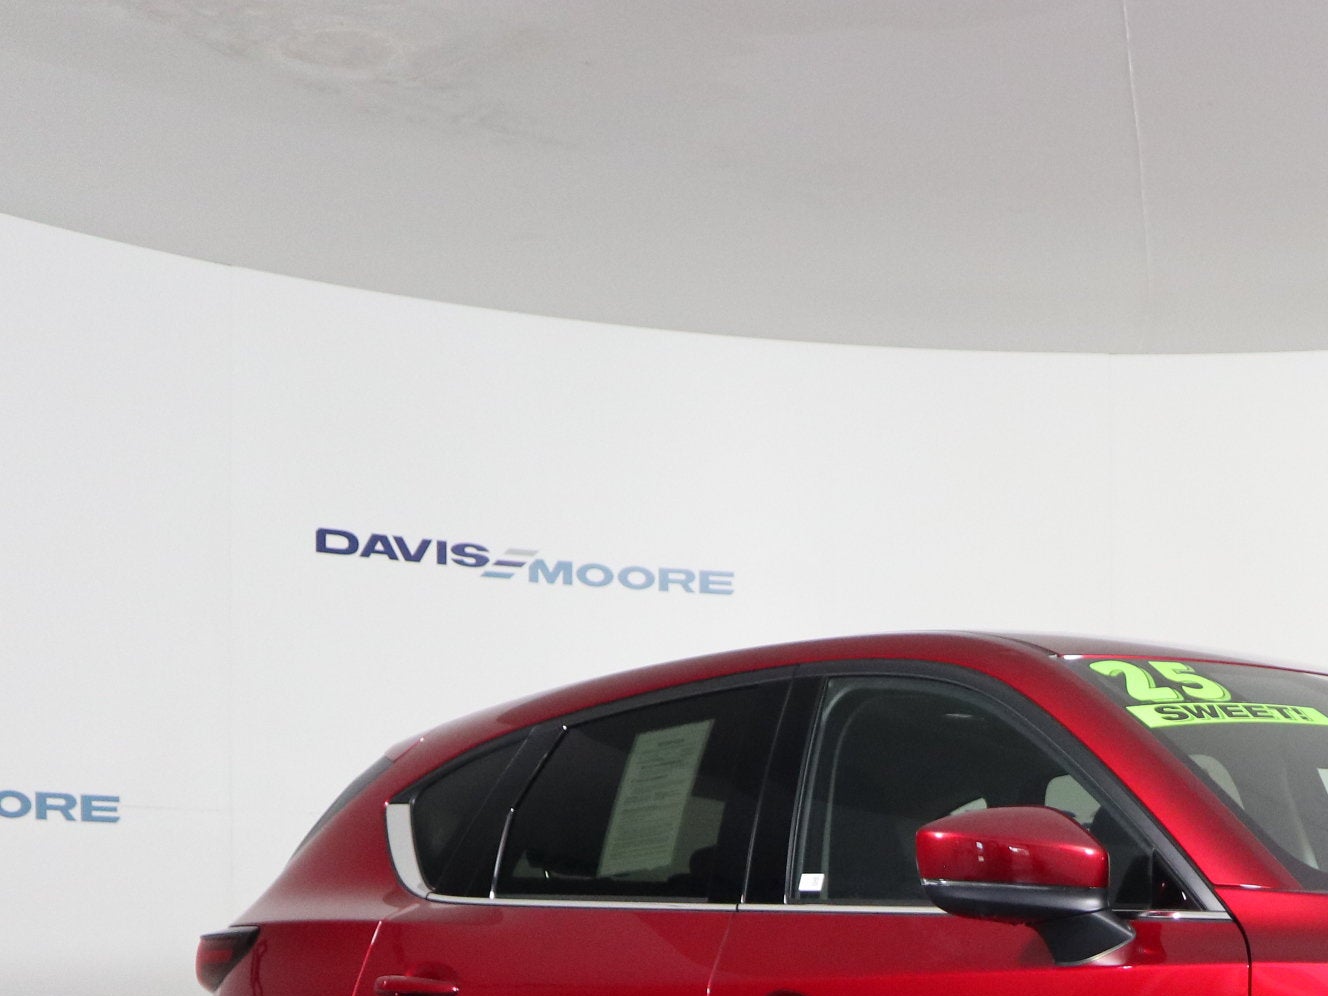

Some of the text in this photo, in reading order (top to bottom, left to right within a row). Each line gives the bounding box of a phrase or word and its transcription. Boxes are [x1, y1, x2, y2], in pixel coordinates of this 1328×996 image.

[315, 527, 735, 595] DAVIS MOORE
[1089, 660, 1232, 702] 25
[1154, 703, 1309, 722] SWEET!
[0, 789, 121, 824] ORE
